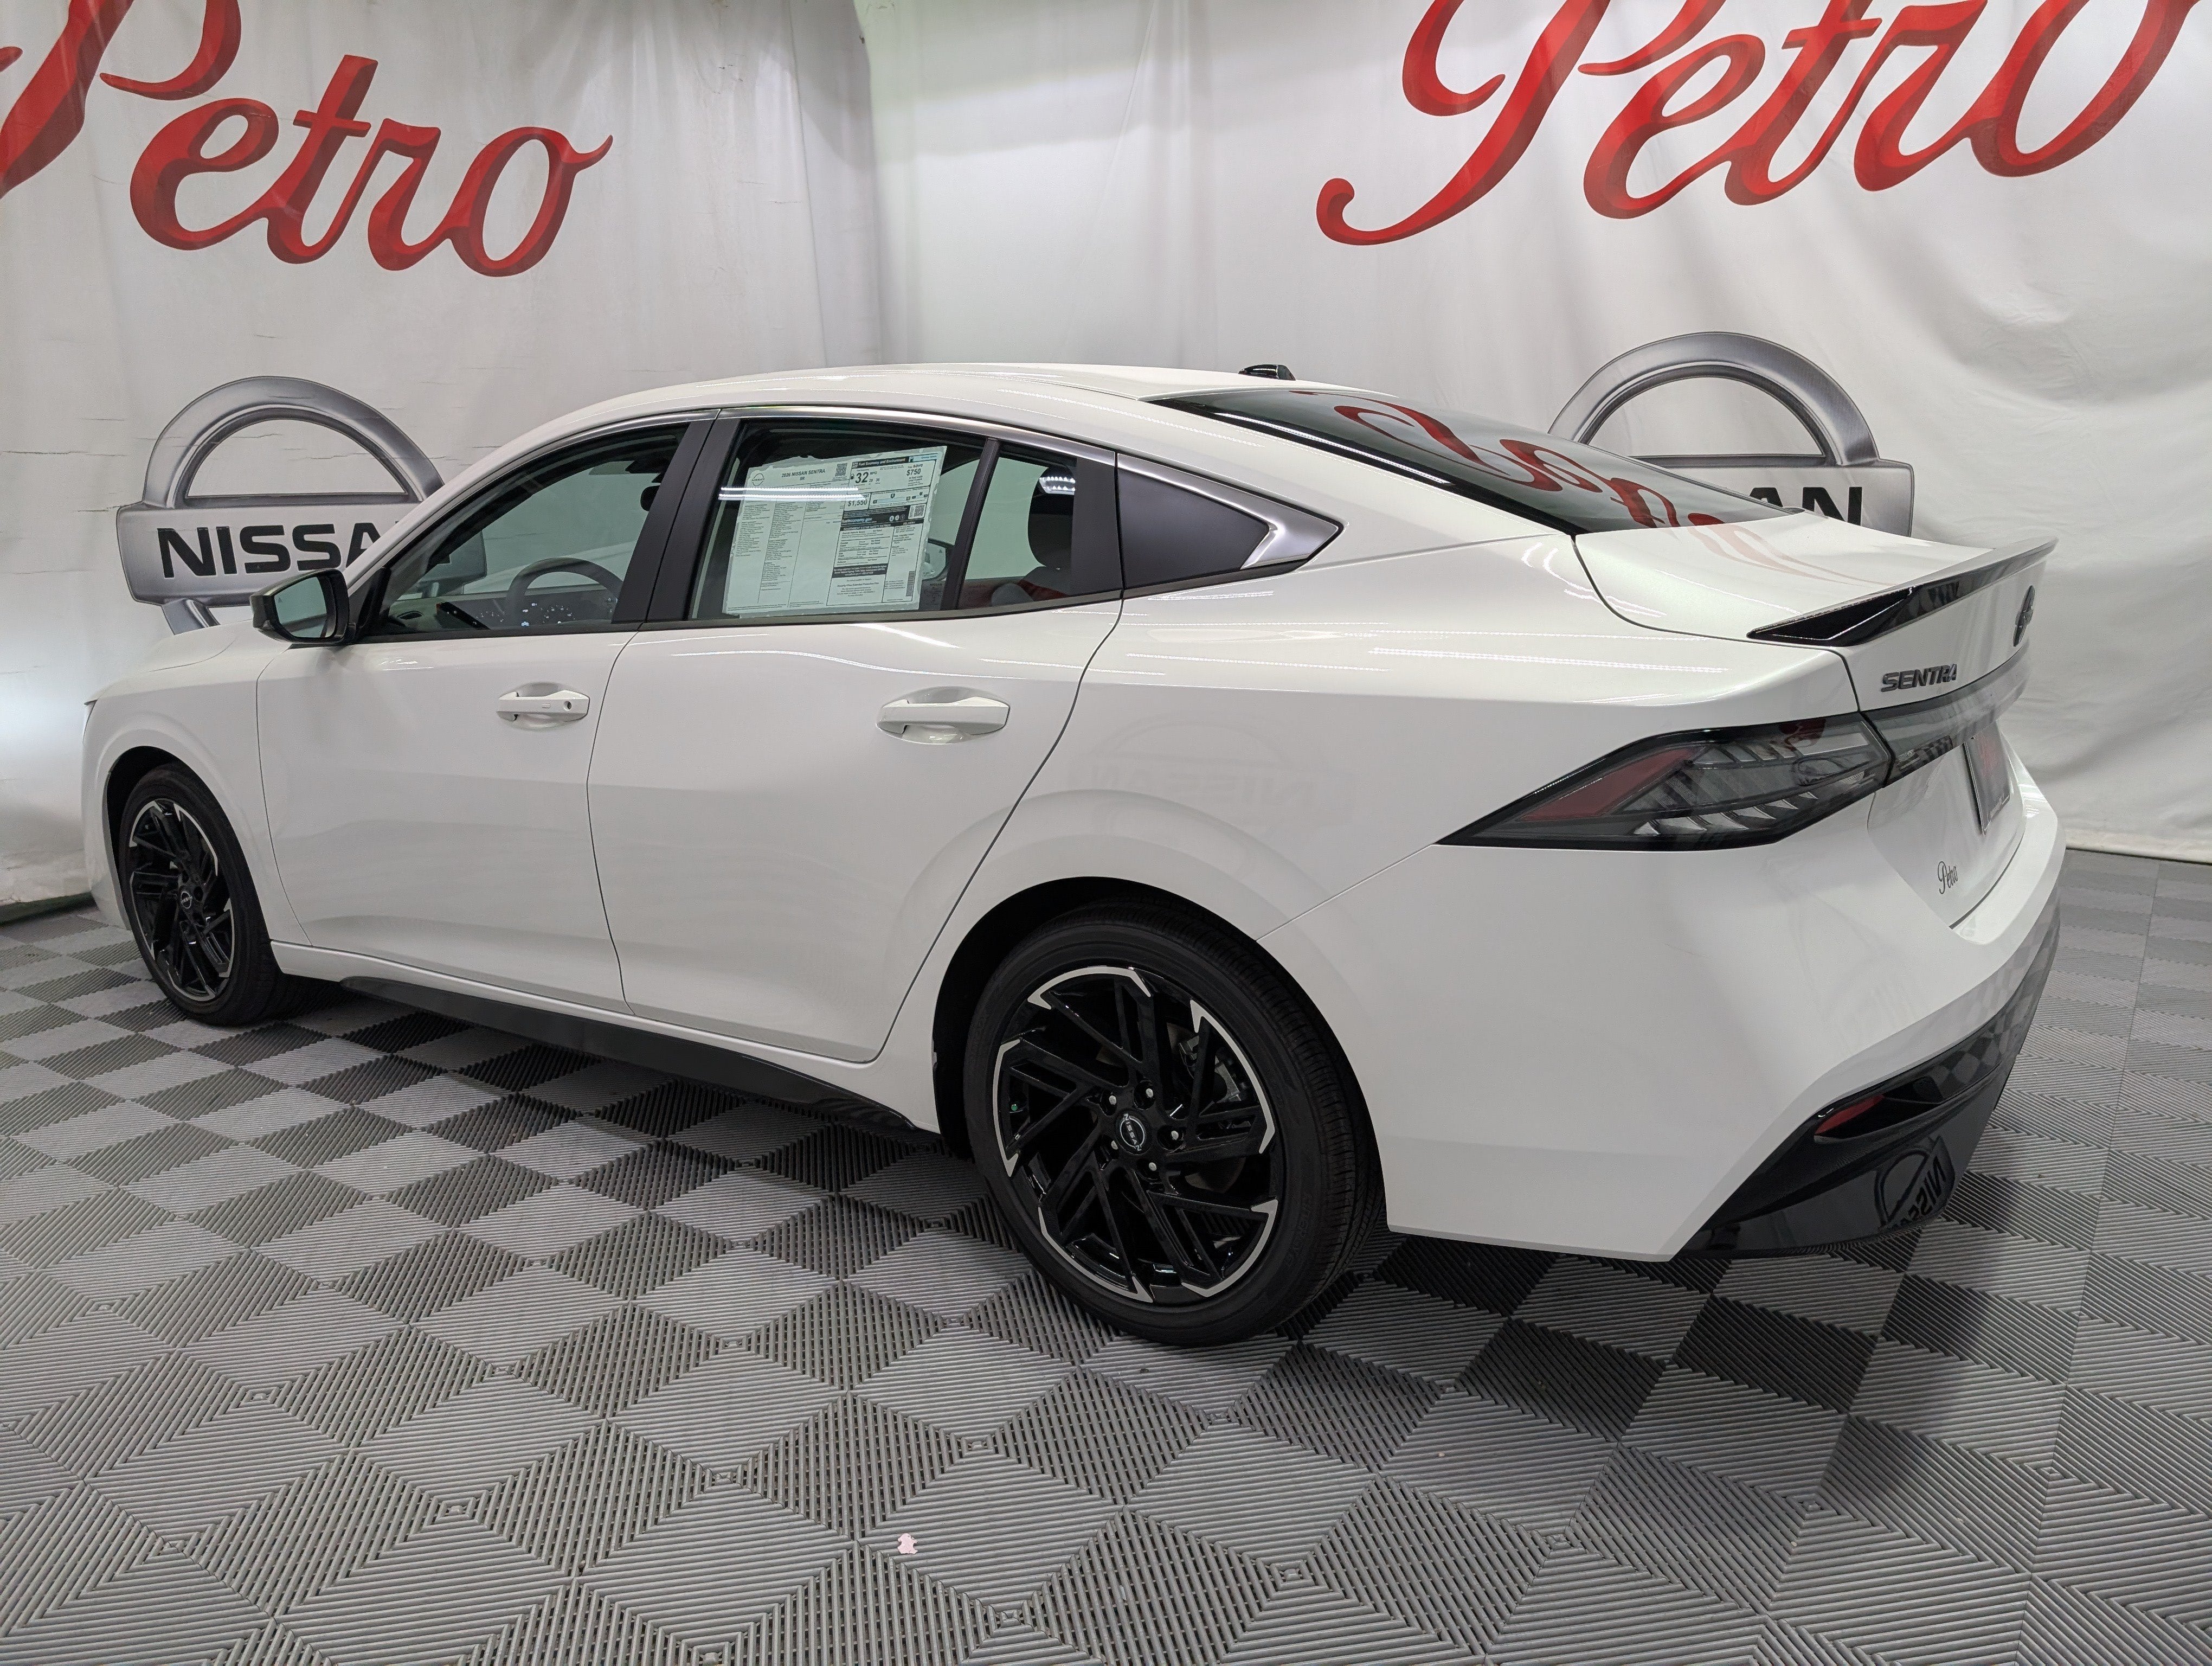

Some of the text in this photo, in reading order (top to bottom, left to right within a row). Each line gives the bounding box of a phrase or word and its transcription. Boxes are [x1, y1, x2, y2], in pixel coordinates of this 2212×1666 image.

[855, 472, 869, 484] 32
[906, 468, 921, 476] $750
[847, 499, 867, 507] $1,550
[157, 521, 400, 579] NISSA
[1880, 663, 1957, 693] SENTRA
[1123, 1113, 1142, 1151] NISSAN
